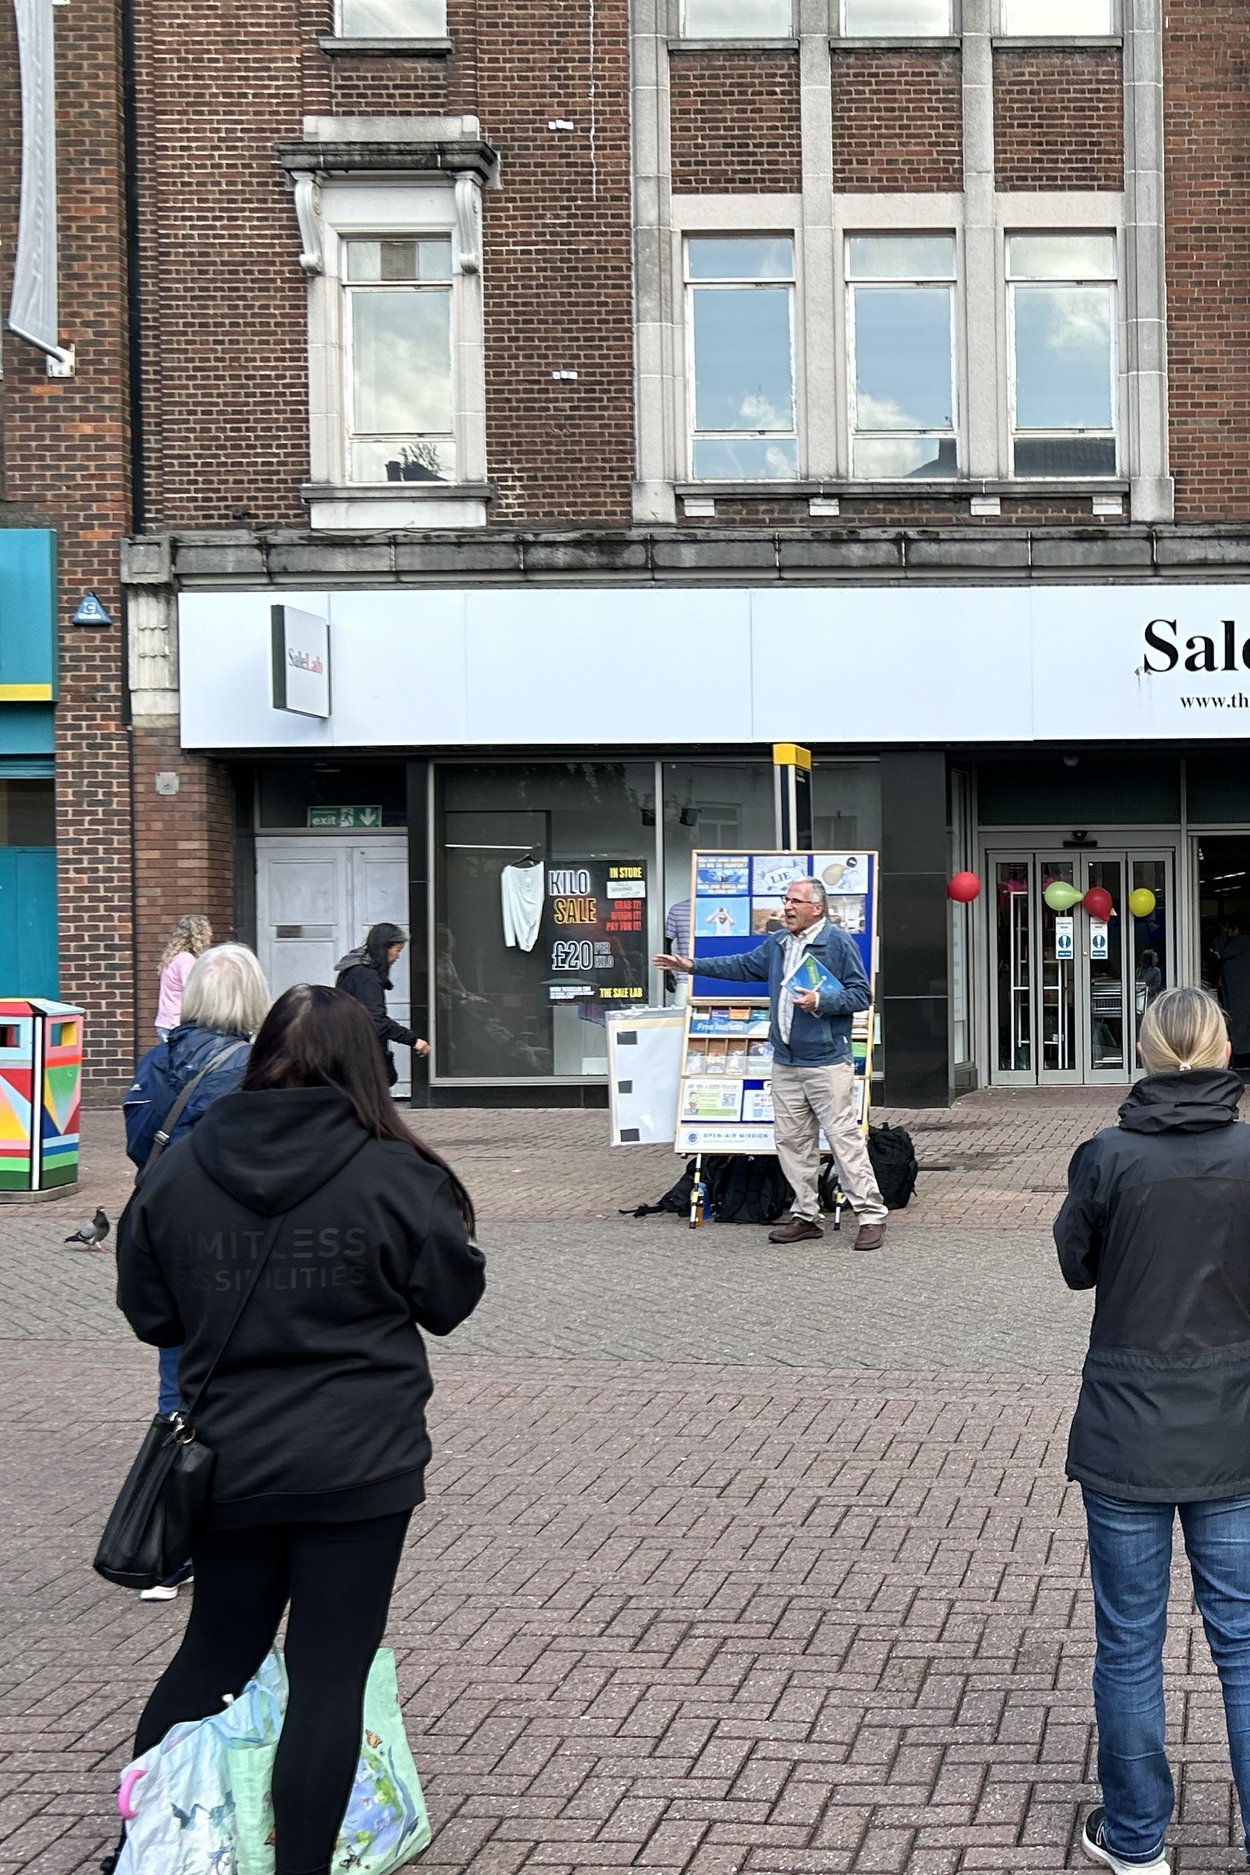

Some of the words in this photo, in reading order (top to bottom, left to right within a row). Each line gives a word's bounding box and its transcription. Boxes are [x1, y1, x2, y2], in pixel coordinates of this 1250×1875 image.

[288, 647, 324, 675] SaleLab
[312, 815, 337, 826] exit
[609, 867, 618, 878] IN
[619, 867, 642, 878] STORE
[770, 871, 792, 884] LIE
[548, 870, 590, 896] KILO
[554, 898, 597, 925] SALE
[552, 940, 593, 970] £20
[599, 987, 612, 998] THE
[612, 987, 629, 998] SALE
[629, 987, 643, 998] LAB
